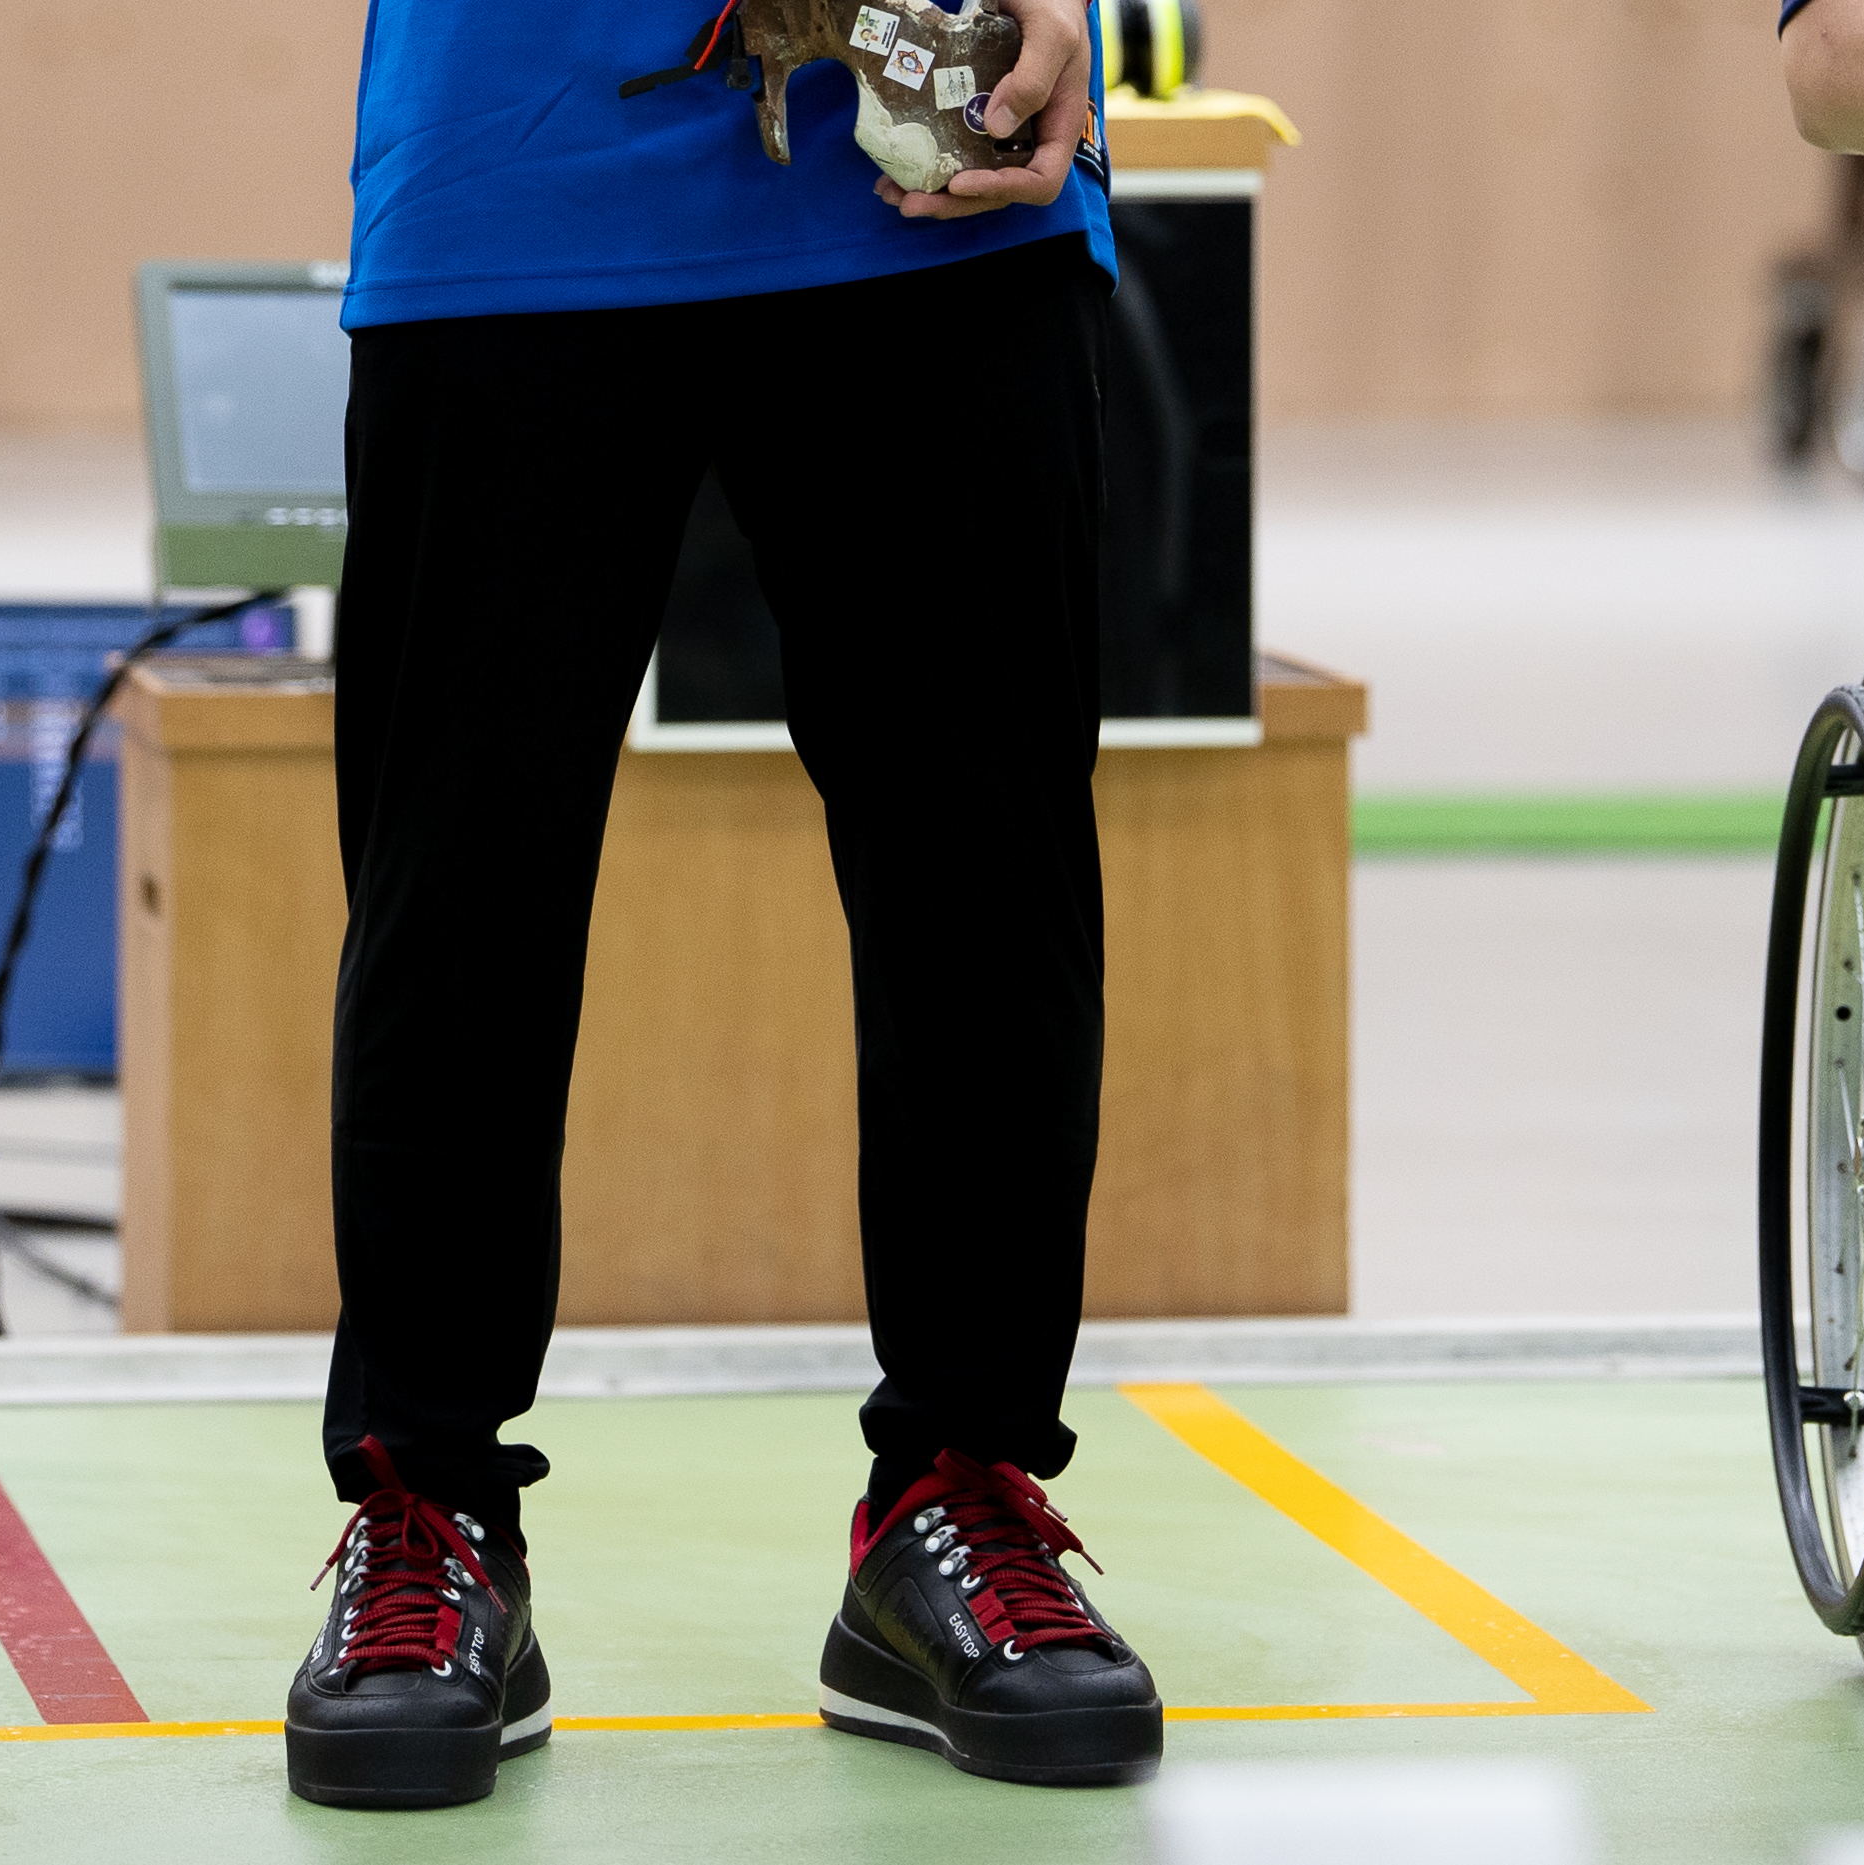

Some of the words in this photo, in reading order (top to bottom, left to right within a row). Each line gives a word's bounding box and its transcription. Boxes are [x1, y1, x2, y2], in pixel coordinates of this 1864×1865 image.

[472, 1627, 485, 1650] TOP
[948, 1612, 971, 1640] EASY
[960, 1633, 980, 1658] TOP
